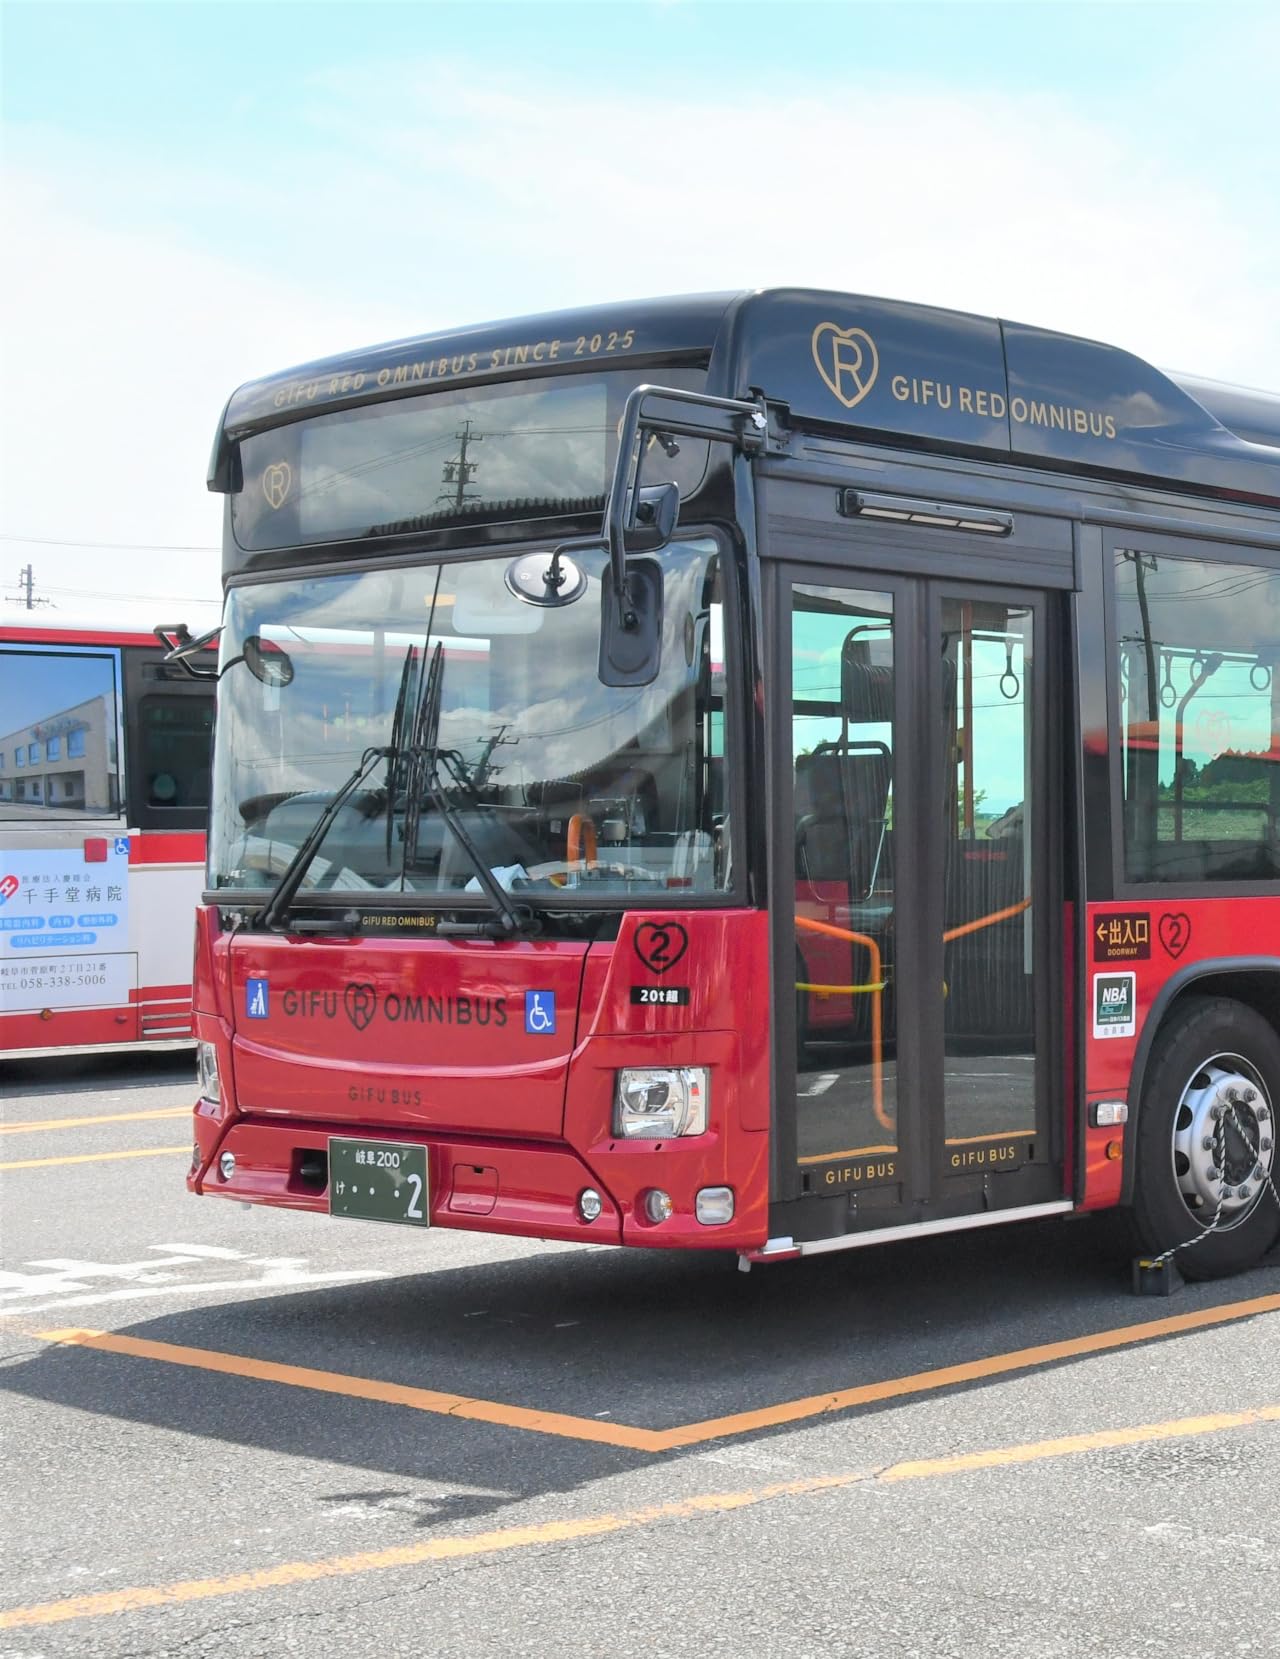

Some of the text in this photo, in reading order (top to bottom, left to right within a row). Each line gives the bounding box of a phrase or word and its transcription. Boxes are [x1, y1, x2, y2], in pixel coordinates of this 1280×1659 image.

[273, 329, 636, 408] GIFU RED OMNIBUS SINCE 2025
[891, 375, 1117, 439] GIFU RED OMNIBUS
[23, 885, 123, 905] 千手堂病院
[362, 916, 435, 927] GIFU RED OMNIBUS
[1109, 919, 1148, 945] 出入口
[1169, 920, 1181, 948] 2
[649, 930, 671, 962] 2
[1107, 947, 1138, 956] DOORWAY
[20, 974, 106, 989] 058-338-5006
[640, 989, 679, 1003] 20t超
[1102, 986, 1128, 1003] NBA
[282, 989, 337, 1018] GIFU
[384, 993, 508, 1028] OMNIBUS
[348, 1085, 422, 1107] GIFU BUS
[951, 1146, 1015, 1168] GIFU BUS
[825, 1162, 895, 1185] GIFU BUS
